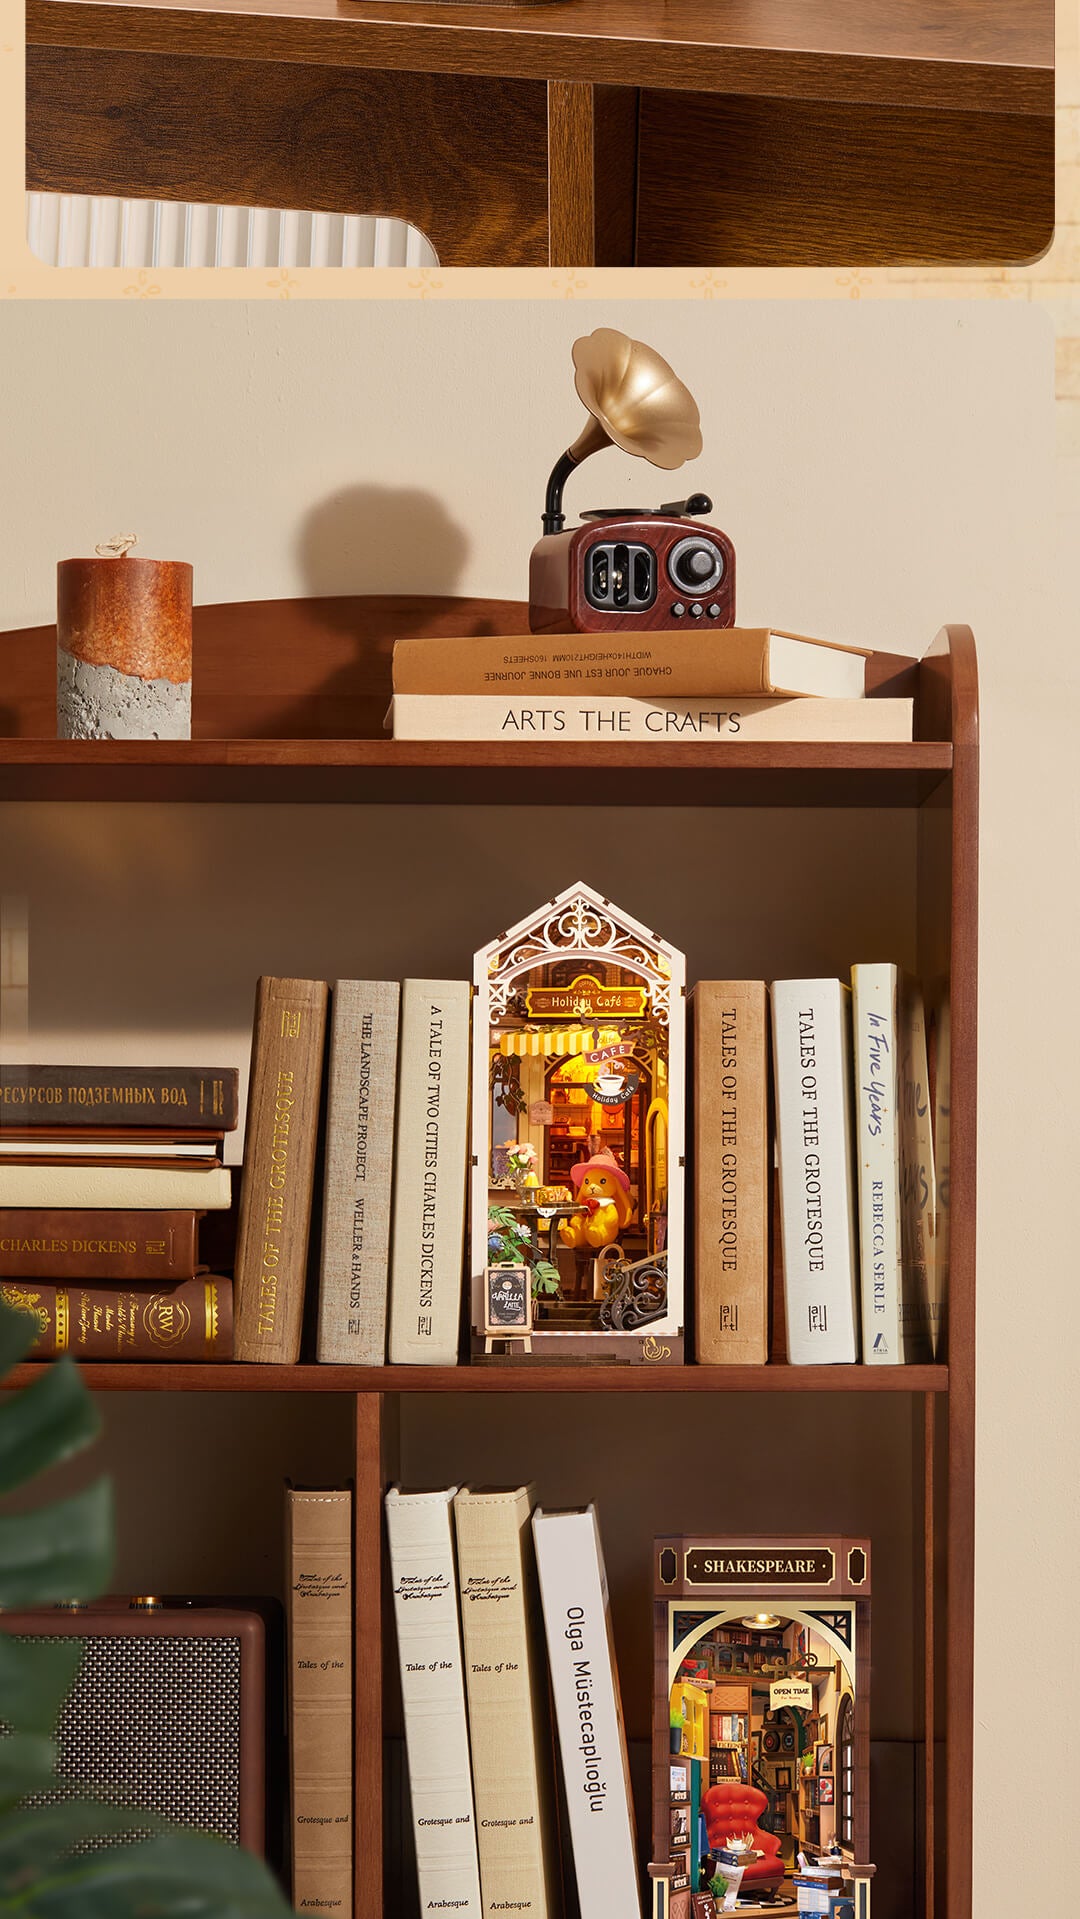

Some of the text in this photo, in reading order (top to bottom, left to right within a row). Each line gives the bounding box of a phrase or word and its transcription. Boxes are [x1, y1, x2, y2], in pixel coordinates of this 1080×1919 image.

[503, 654, 547, 664] 160SHEETS
[484, 666, 672, 681] CHAQUE JOUR EST UNE BONNE JOURNEE
[501, 709, 741, 733] ARTS THE CRAFTS
[596, 995, 621, 1007] Café
[361, 1013, 373, 1039] THE
[590, 1045, 626, 1062] CAFE
[358, 1042, 372, 1121] LANDSCAPE
[862, 1012, 889, 1137] In Five Years
[68, 1087, 156, 1106] ПОДЗЕМНЫХ
[161, 1087, 188, 1106] ВОД
[592, 1086, 635, 1104] Holiday Café
[719, 1008, 738, 1272] TALES OF THE GROTESQUE
[799, 1008, 824, 1272] TALES OF THE GROTESQUE
[419, 1005, 442, 1308] A TALE OF TWO CITIES CHARLES DICKENS
[258, 1071, 295, 1334] TALES OF THE GROTESQUE
[352, 1198, 364, 1252] WELLER
[0, 1239, 137, 1254] CHARLES DICKENS
[872, 1180, 885, 1314] REBECCA SERLE
[351, 1253, 360, 1261] &
[350, 1263, 362, 1309] HANDS
[158, 1305, 173, 1333] RW
[704, 1559, 816, 1574] SHAKESPEARE
[323, 1574, 332, 1584] of
[332, 1574, 343, 1582] the
[423, 1576, 432, 1585] of
[432, 1574, 444, 1582] the
[490, 1577, 500, 1586] of
[500, 1575, 511, 1583] the
[297, 1660, 344, 1671] Tales of the
[406, 1661, 453, 1672] Tales of the
[472, 1663, 519, 1673] Tales of the
[773, 1688, 792, 1696] OPEN
[565, 1606, 607, 1812] Olga Müstecaplıoğlu
[297, 1815, 349, 1826] Grotesque and
[418, 1815, 470, 1827] Grotesque and
[481, 1817, 534, 1828] Grotesque and
[300, 1898, 342, 1908] Arabesque
[427, 1899, 469, 1909] Arabesque
[490, 1901, 532, 1910] Arabesque
